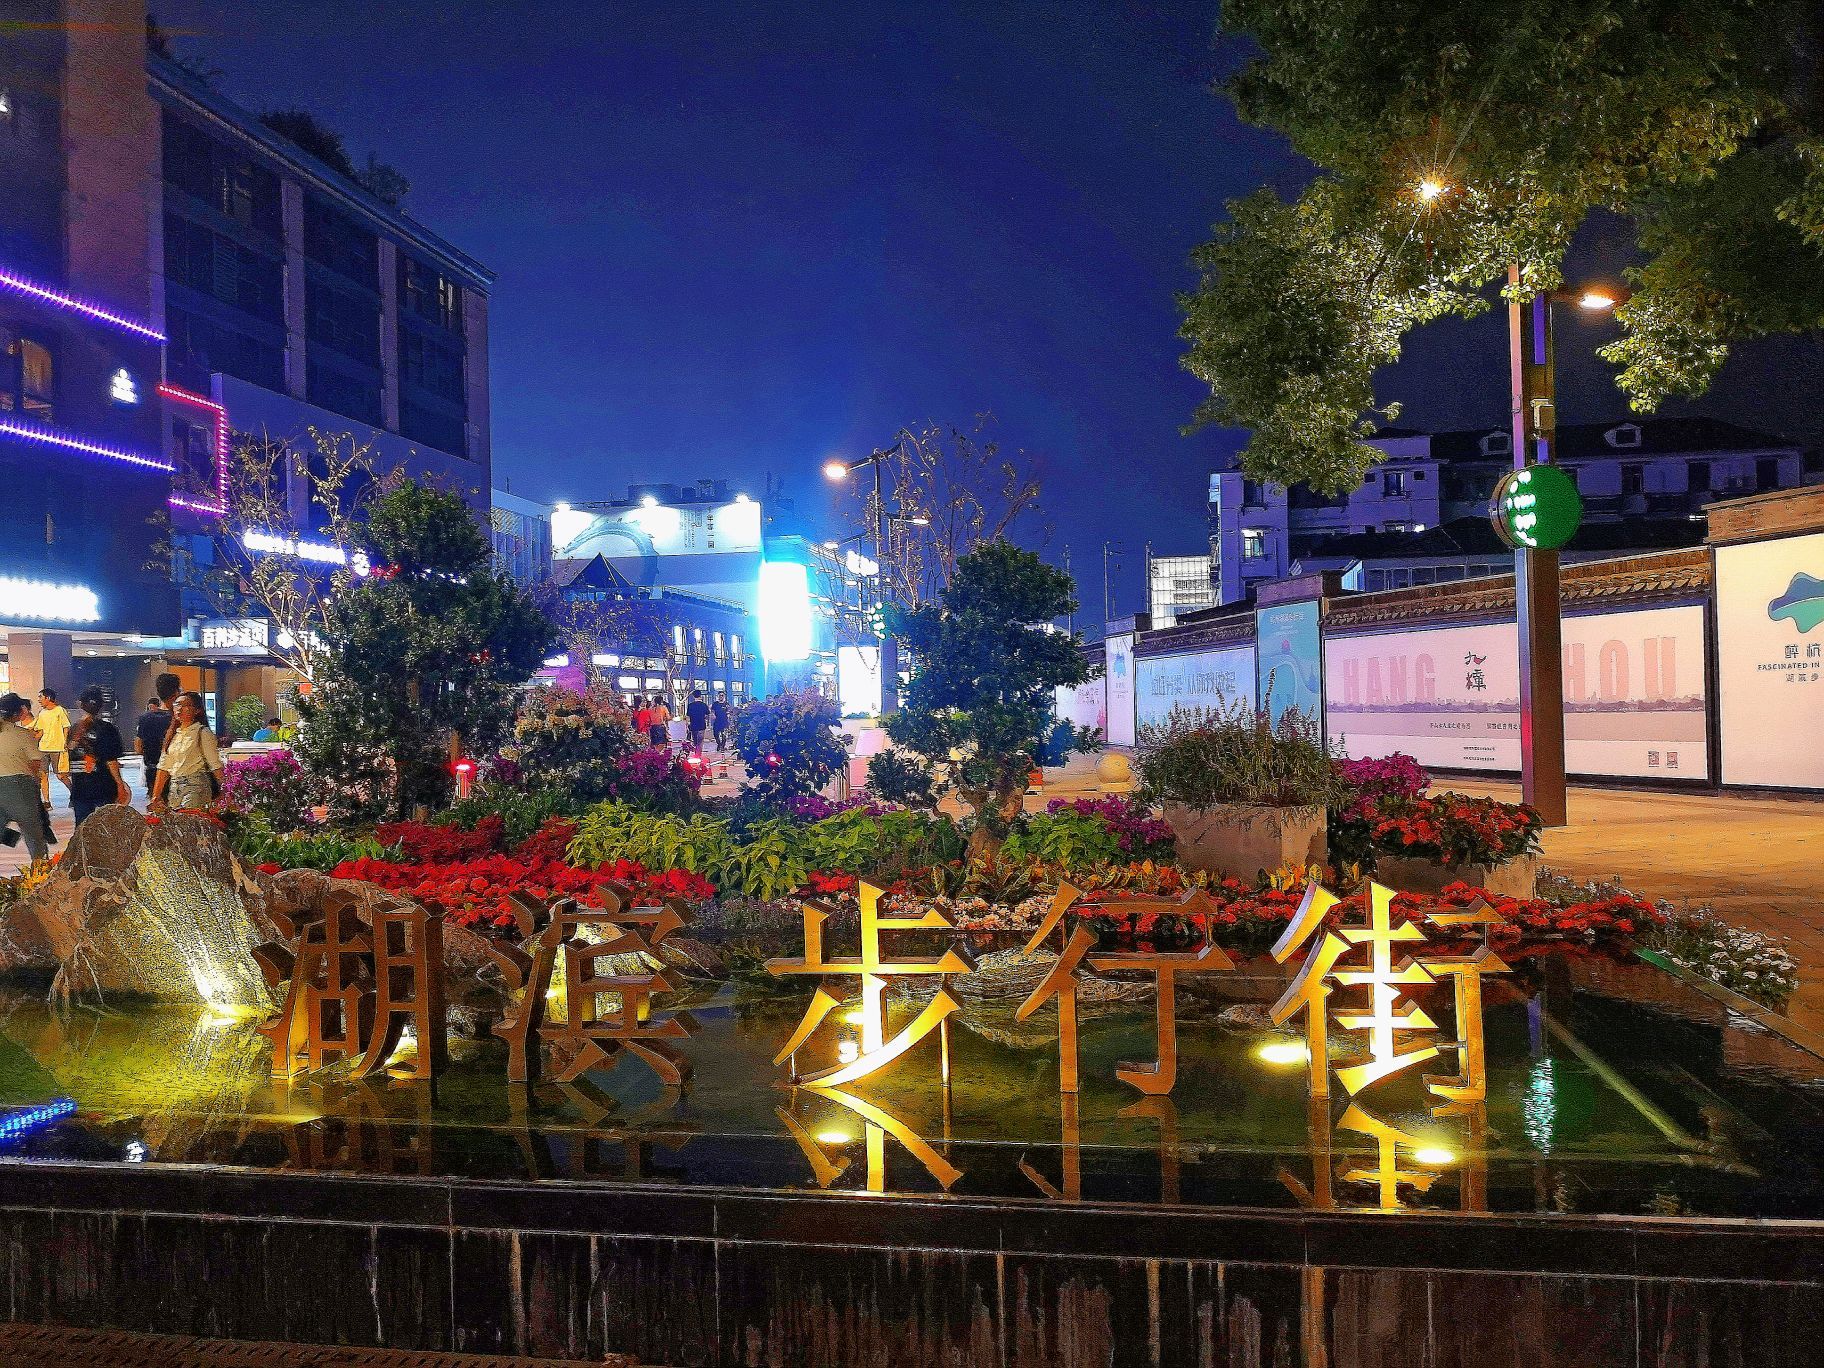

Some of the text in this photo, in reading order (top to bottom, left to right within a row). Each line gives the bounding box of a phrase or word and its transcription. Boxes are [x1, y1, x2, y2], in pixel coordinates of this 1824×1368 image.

[1343, 636, 1677, 704] HANG HOU
[1757, 660, 1820, 672] FASCINATED IN
[250, 880, 1514, 1102] 湖滨步行街
